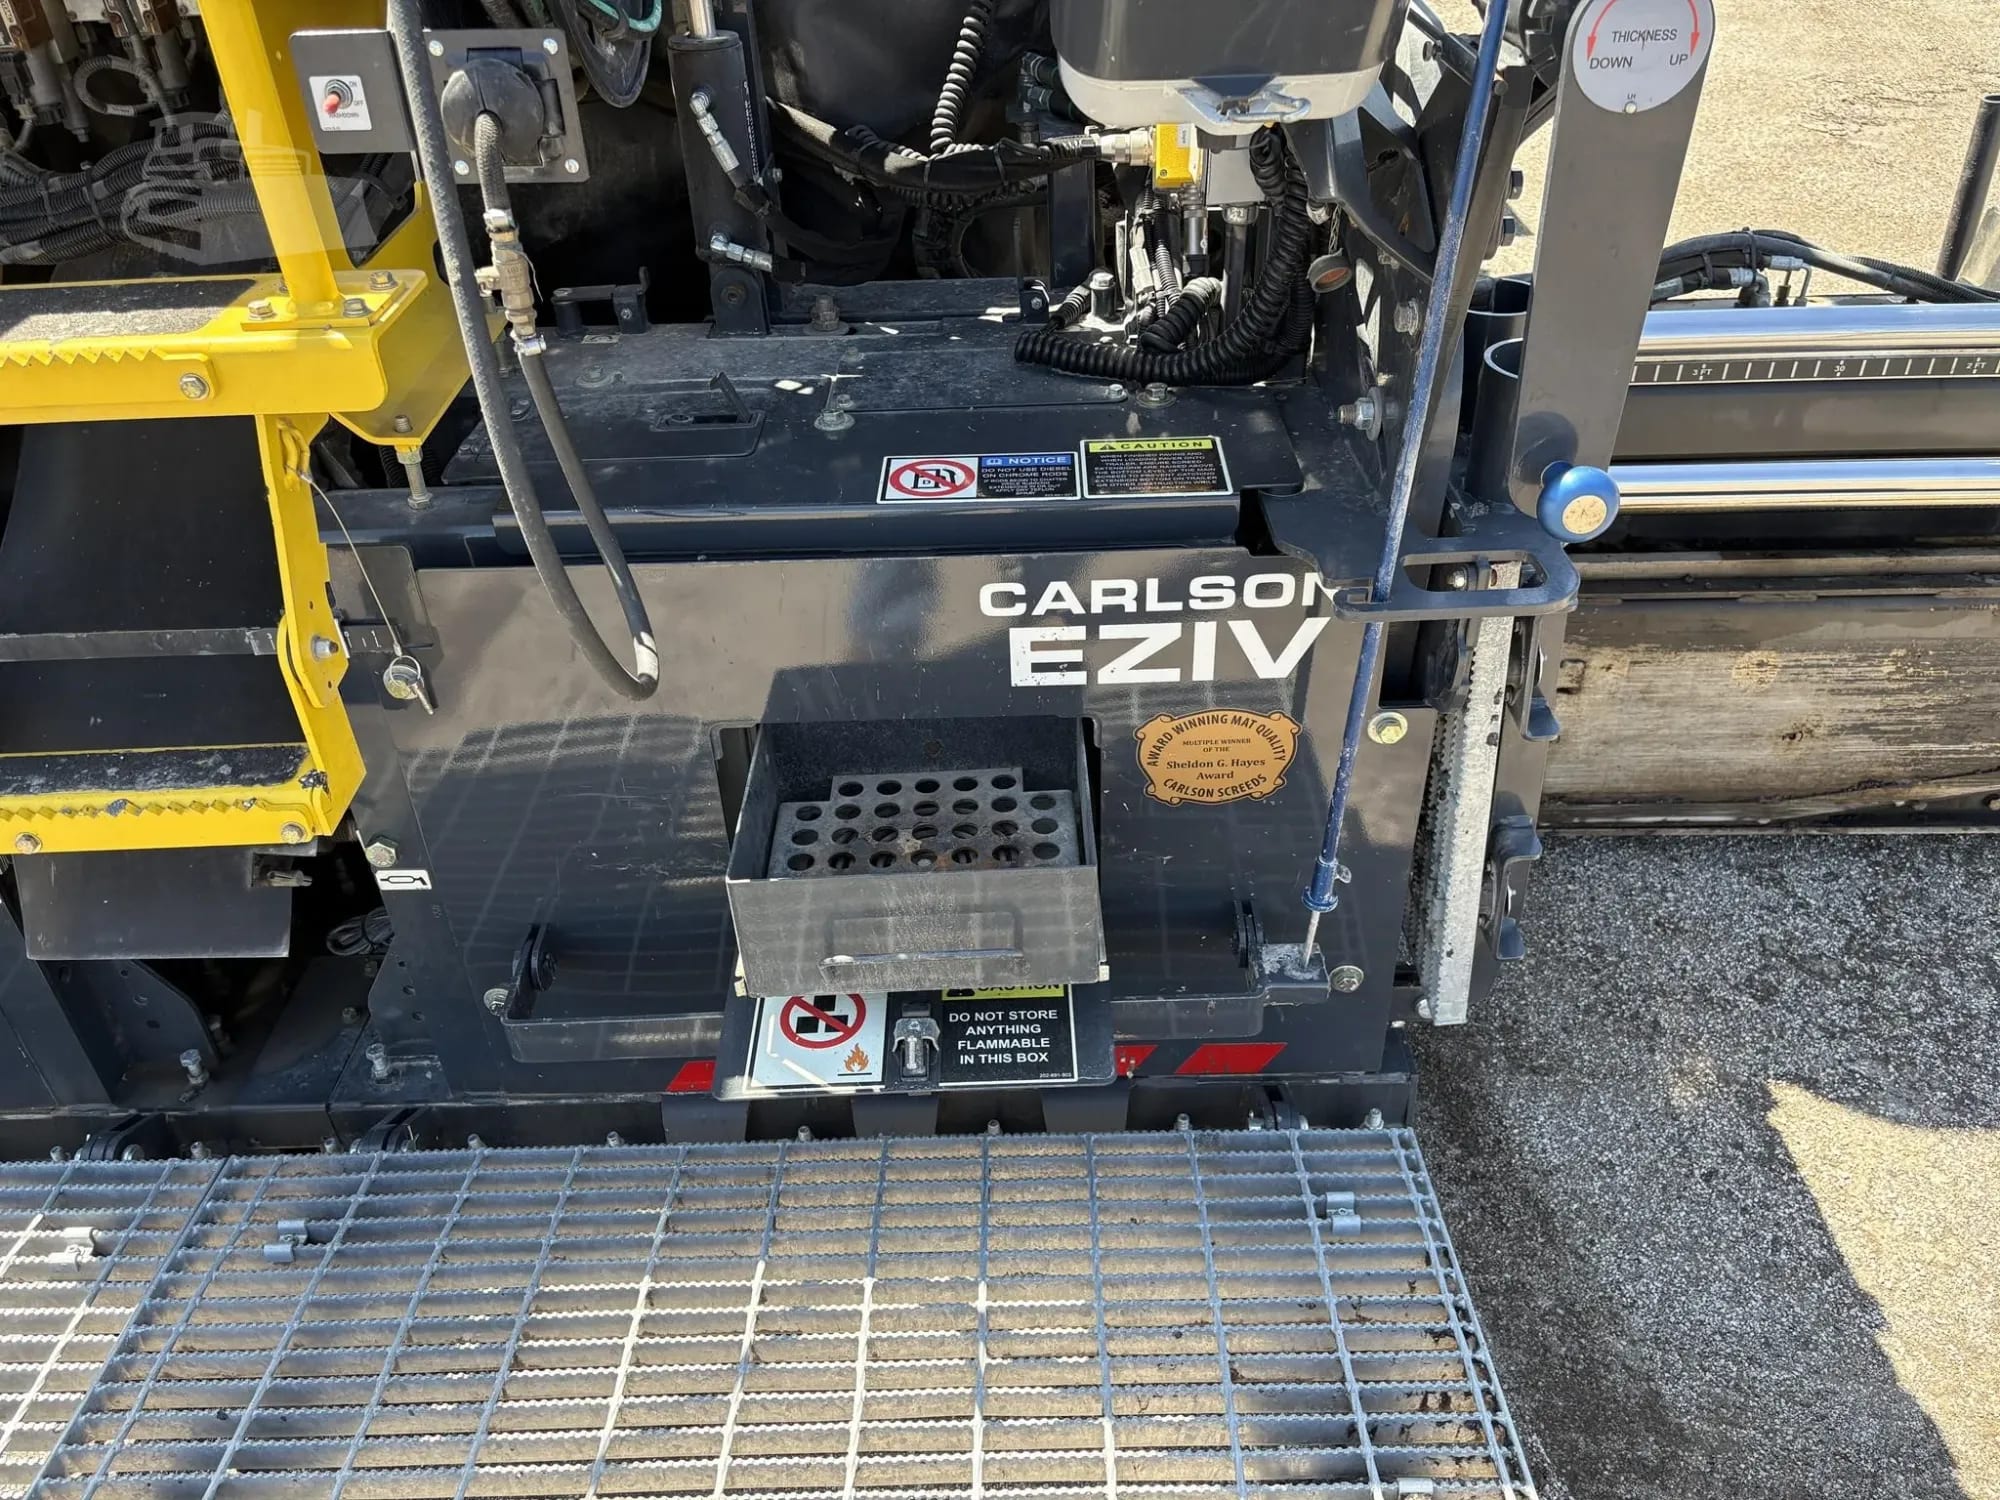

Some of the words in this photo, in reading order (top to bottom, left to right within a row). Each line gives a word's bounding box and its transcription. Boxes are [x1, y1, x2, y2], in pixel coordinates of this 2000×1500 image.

[1612, 28, 1678, 43] THICKNESS
[1590, 56, 1633, 70] DOWN
[1670, 54, 1688, 66] UP
[1120, 441, 1204, 449] CAUTION
[1008, 456, 1068, 464] NOTICE
[1009, 616, 1331, 687] EZIV
[1146, 732, 1173, 767] AWARD
[1172, 714, 1228, 735] WINNING
[1230, 715, 1258, 730] MAT
[1256, 724, 1286, 761] QUALITY
[1166, 760, 1213, 769] Sheldon
[1231, 758, 1266, 769] Hayes
[1196, 771, 1234, 780] Award
[1164, 778, 1215, 798] CARLSON
[1218, 773, 1267, 798] SCREEDS
[949, 1012, 970, 1022] DO
[975, 1011, 1004, 1021] NOT
[1009, 1010, 1058, 1020] STORE
[966, 1024, 1041, 1036] ANYTHING
[958, 1038, 1050, 1050] FLAMMABLE
[960, 1054, 974, 1065] IN
[978, 1053, 1012, 1064] THIS
[1017, 1052, 1048, 1063] BOX
